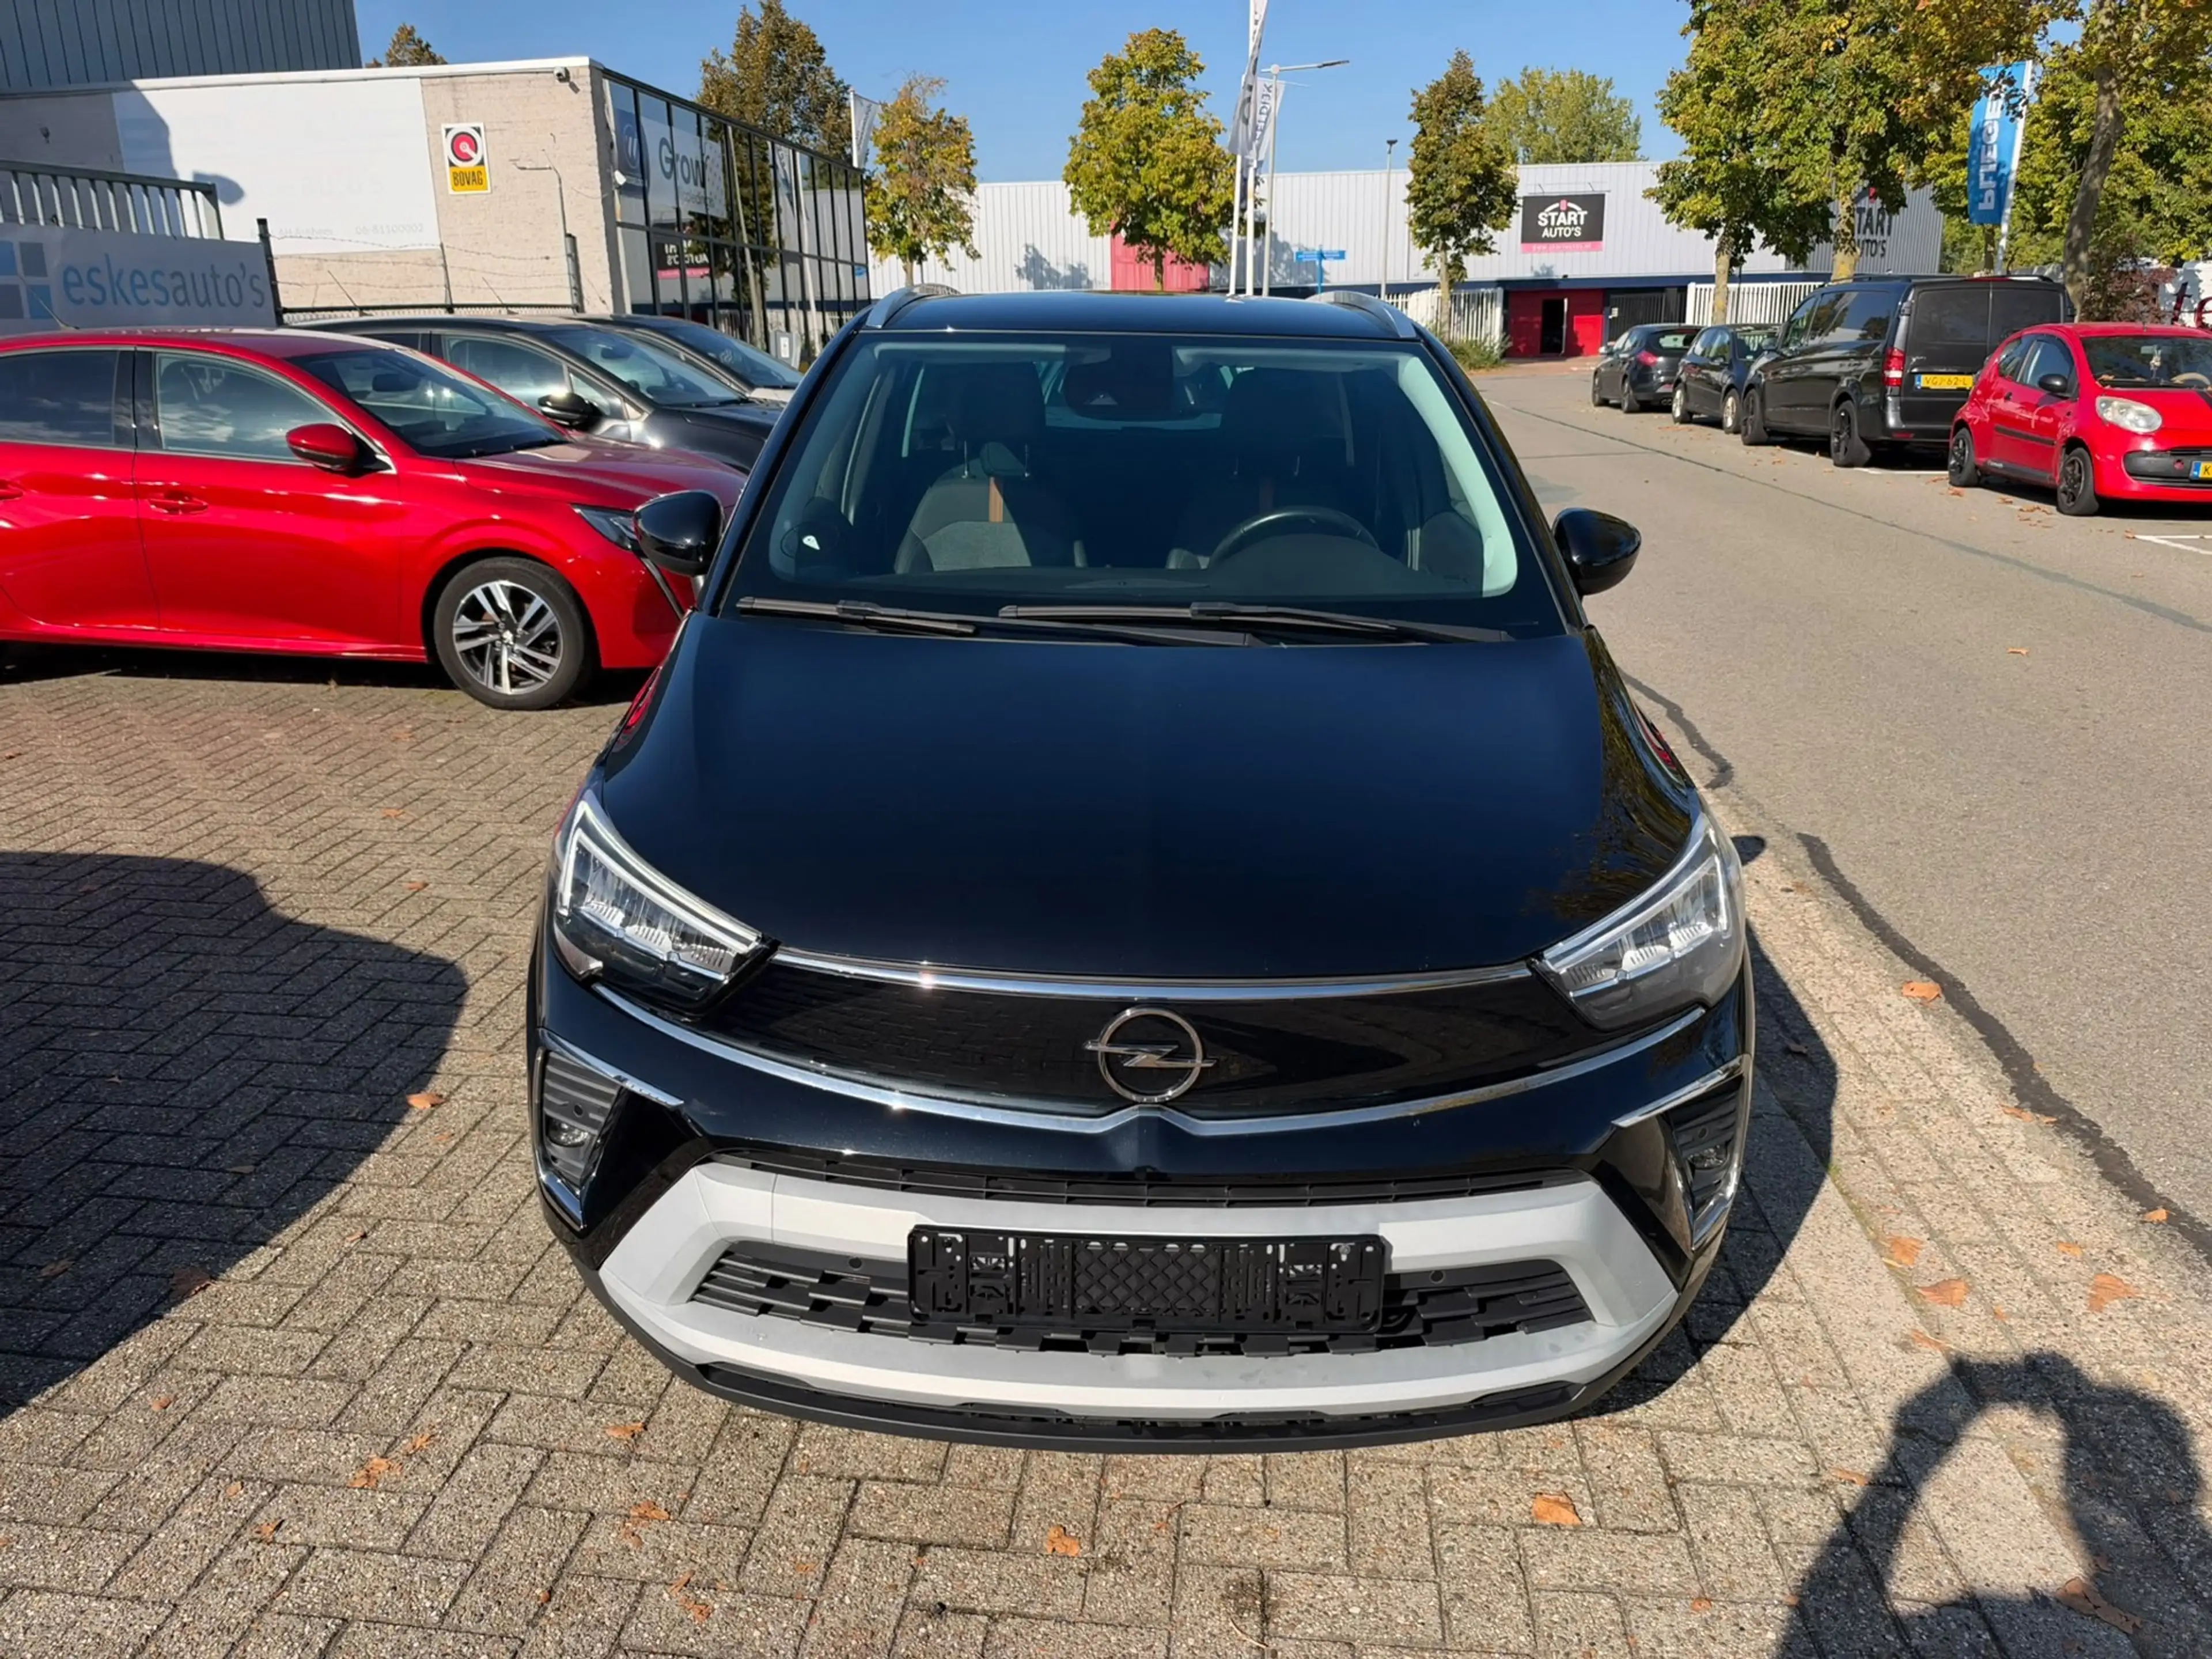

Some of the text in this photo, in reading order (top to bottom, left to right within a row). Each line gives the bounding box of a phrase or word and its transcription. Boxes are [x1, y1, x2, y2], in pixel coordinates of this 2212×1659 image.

[452, 170, 483, 187] BOVAG
[1538, 210, 1588, 226] START
[1541, 226, 1582, 238] AUTO'S
[63, 252, 265, 308] eskesauto's
